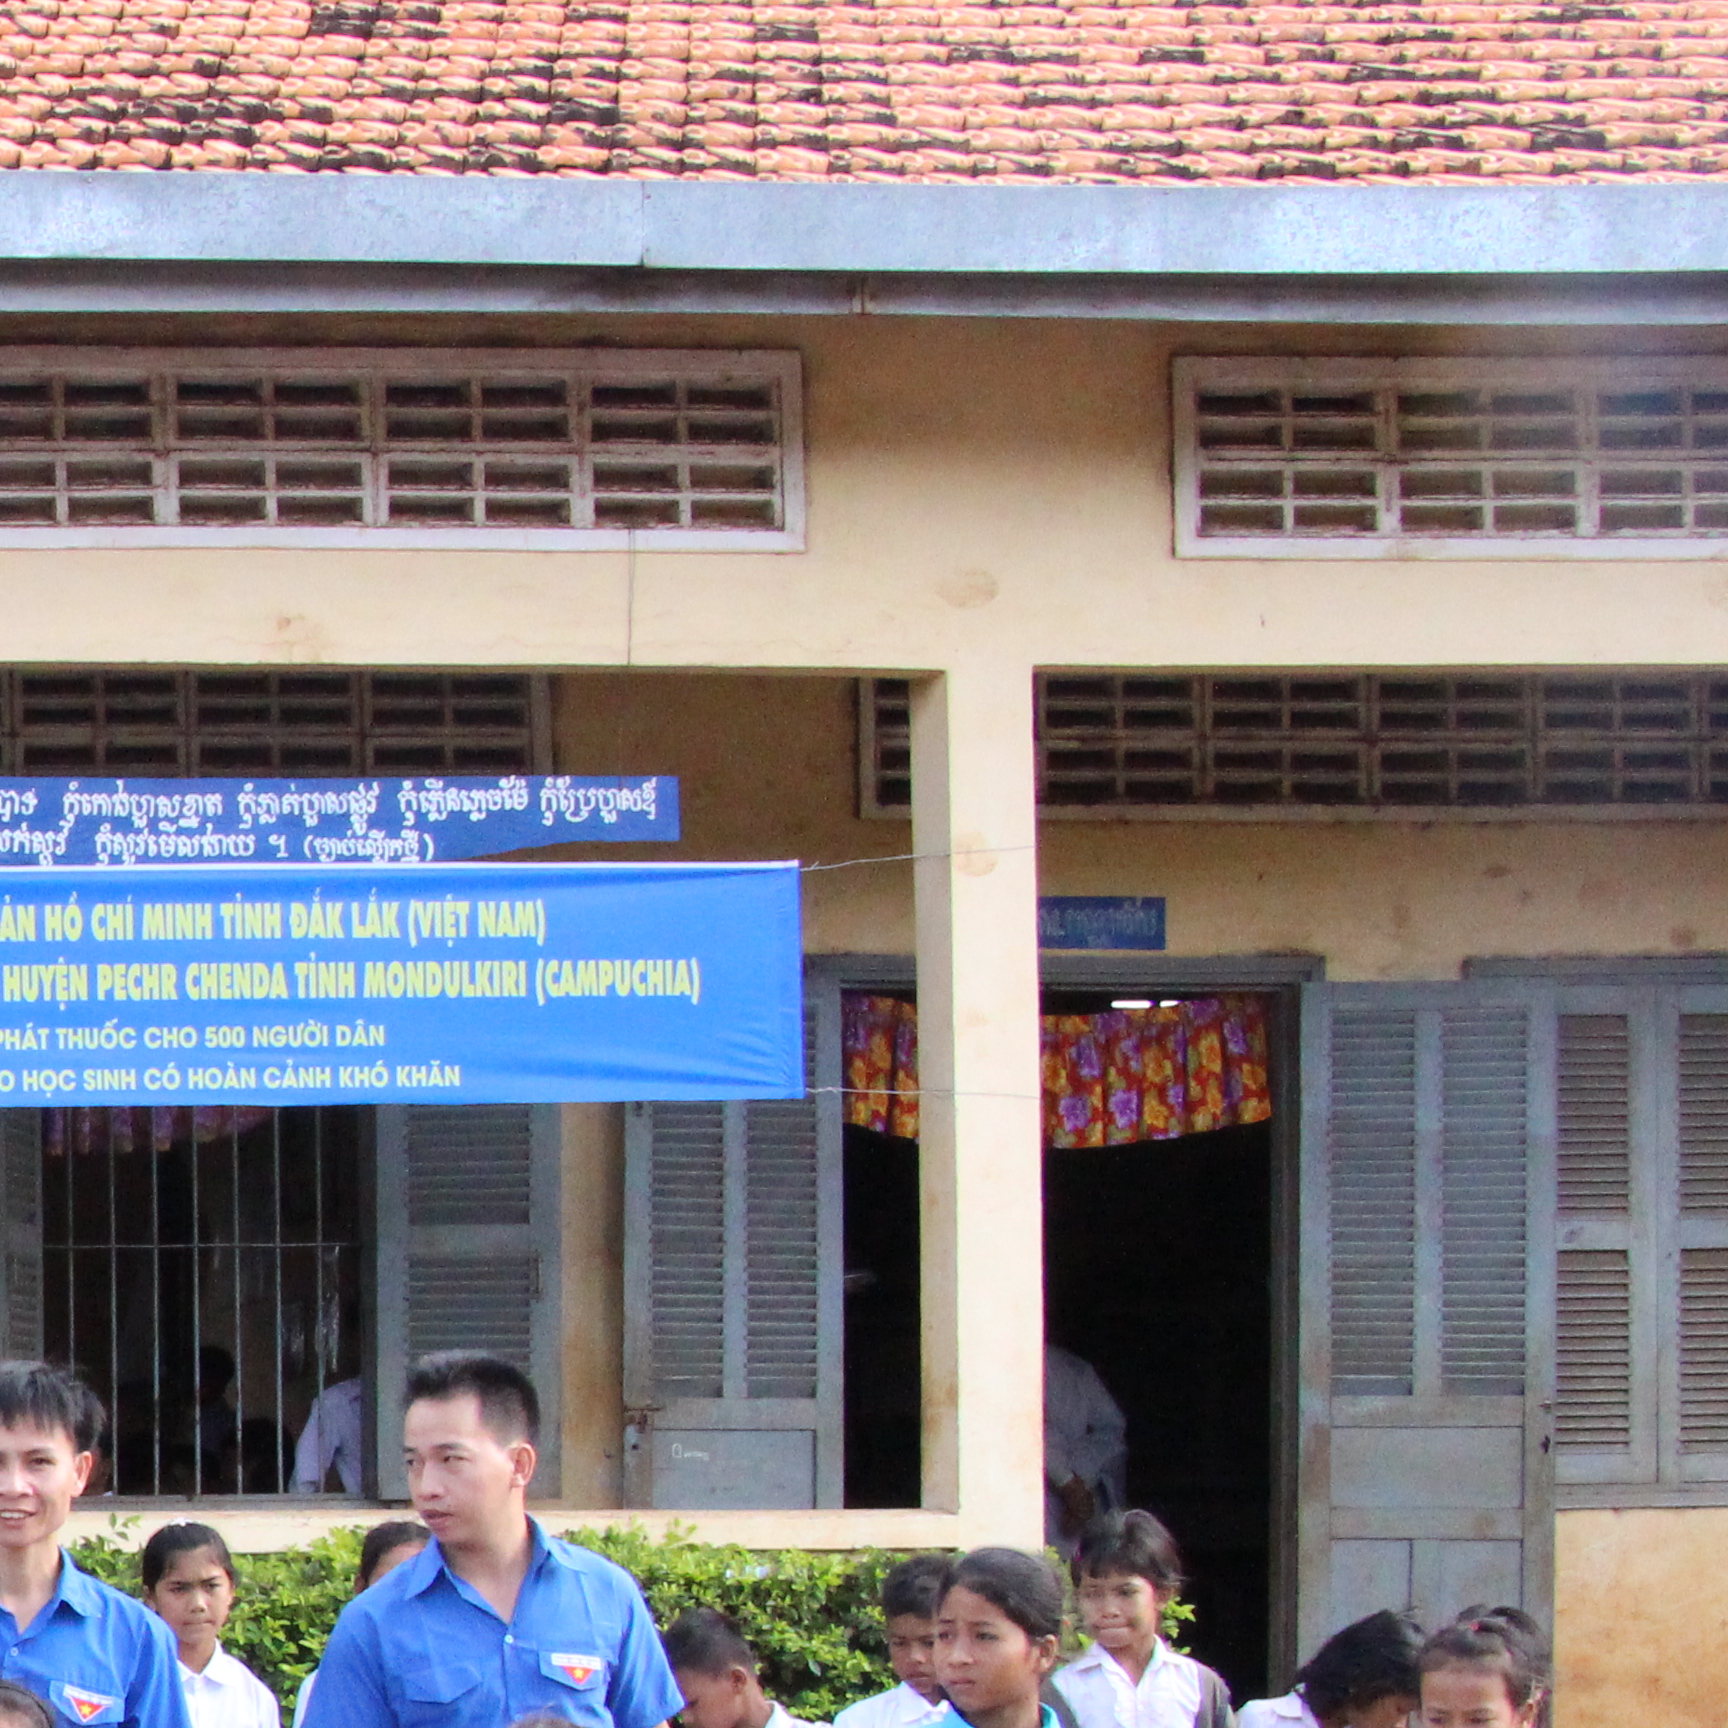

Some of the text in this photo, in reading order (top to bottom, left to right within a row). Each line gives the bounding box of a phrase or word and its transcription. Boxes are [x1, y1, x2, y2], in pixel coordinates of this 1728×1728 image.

[90, 896, 135, 942] CHÍ
[141, 902, 215, 941] MINH
[219, 892, 283, 940] TỈNH
[407, 893, 472, 948] (VIỆT
[477, 897, 547, 947] NAM)
[2, 956, 89, 1011] HUYỆN
[96, 962, 179, 1001] PECHR
[184, 961, 290, 1001] CHENDA
[294, 951, 357, 999] TỈNH
[363, 959, 528, 999] MONDULKIRI
[535, 957, 701, 1007] (CAMPUCHIA)
[55, 1017, 138, 1050] THUỐC
[143, 1025, 199, 1050] CHO
[204, 1025, 247, 1049] 500
[335, 1018, 386, 1047] DÂN
[22, 1068, 77, 1099] HỌC
[82, 1068, 138, 1092] SINH
[143, 1061, 183, 1091] CÓ
[187, 1060, 258, 1090] HOÀN
[262, 1057, 333, 1089] CẢNH
[338, 1059, 391, 1089] KHÓ
[395, 1059, 462, 1088] KHĂN
